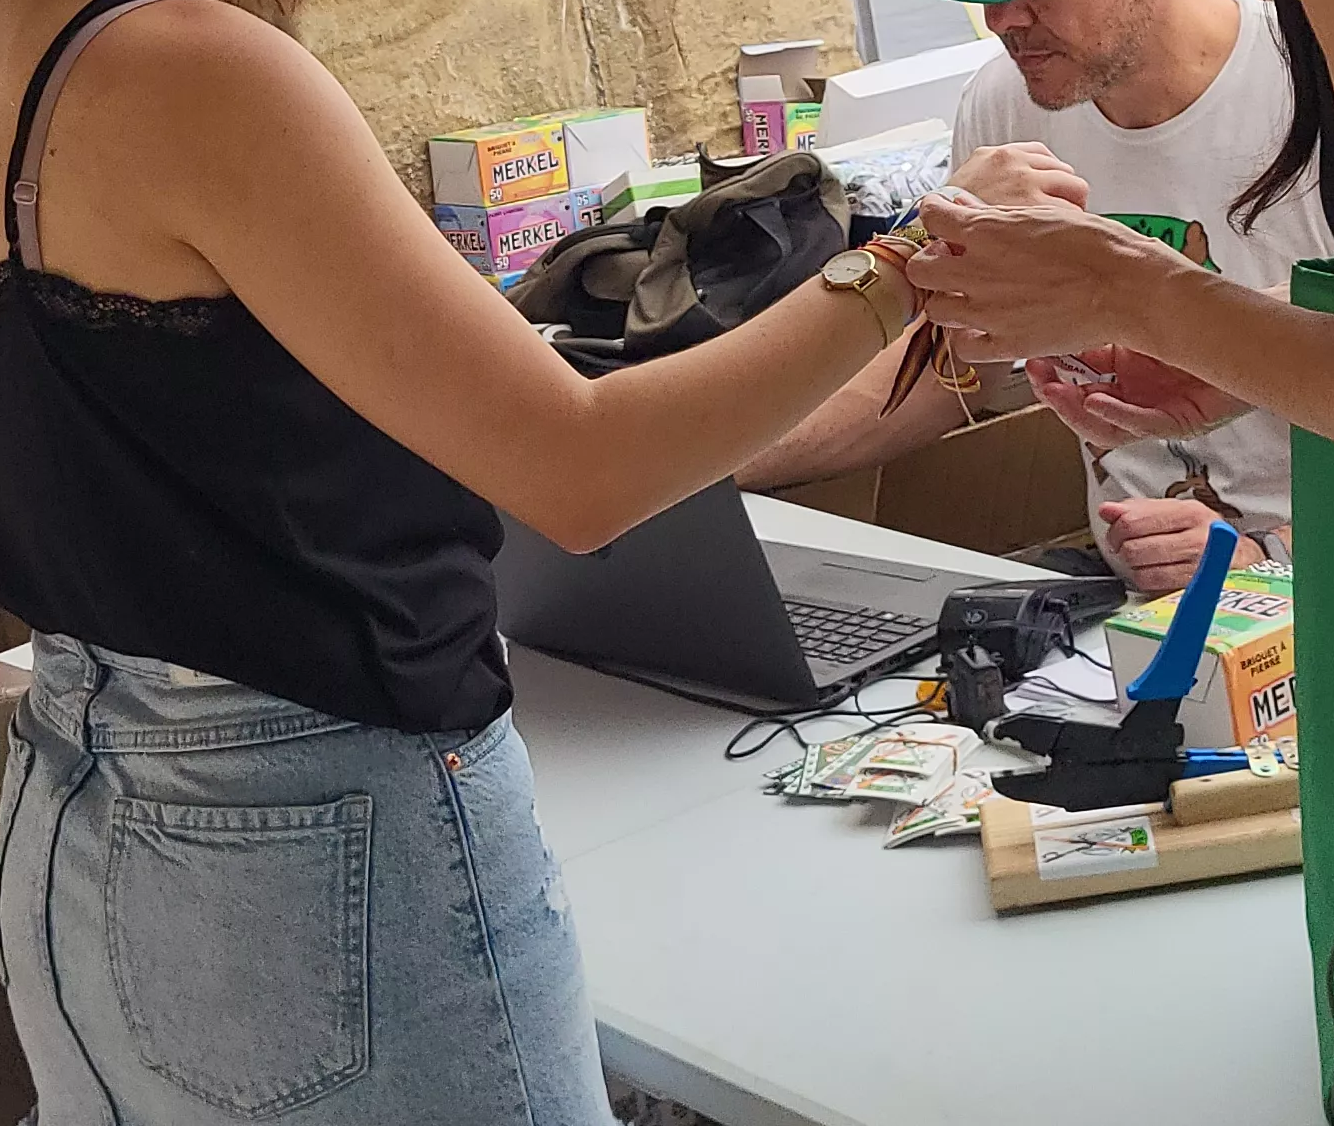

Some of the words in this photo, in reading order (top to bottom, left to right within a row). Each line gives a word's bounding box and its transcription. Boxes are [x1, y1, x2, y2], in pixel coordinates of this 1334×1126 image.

[493, 152, 559, 184] MERKEL
[490, 188, 503, 201] 50
[499, 221, 566, 254] MERKEL
[495, 257, 509, 270] 50
[1240, 645, 1278, 670] BRIQUET
[1250, 654, 1282, 678] PIERRE
